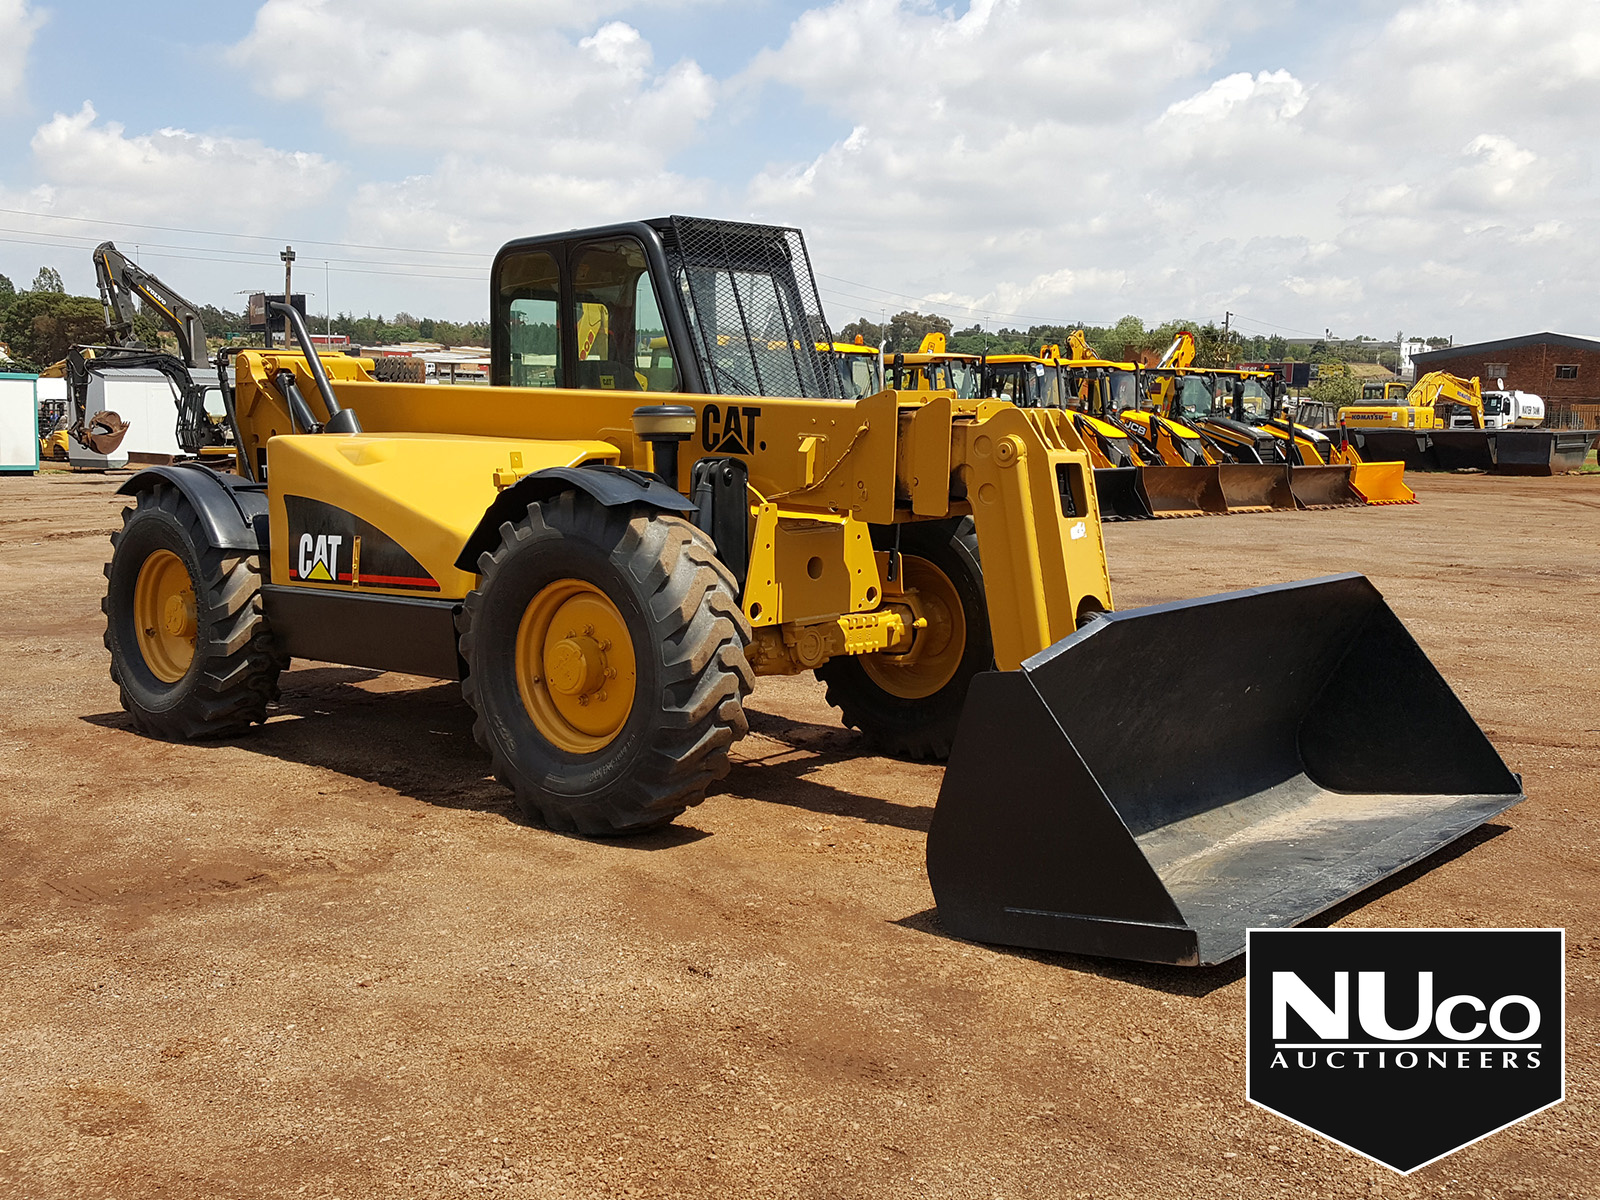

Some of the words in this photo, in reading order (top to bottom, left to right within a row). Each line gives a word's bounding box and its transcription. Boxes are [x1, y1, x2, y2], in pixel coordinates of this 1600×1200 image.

[146, 284, 167, 305] VOLVO
[1125, 421, 1147, 436] JCB
[298, 532, 342, 581] CAT
